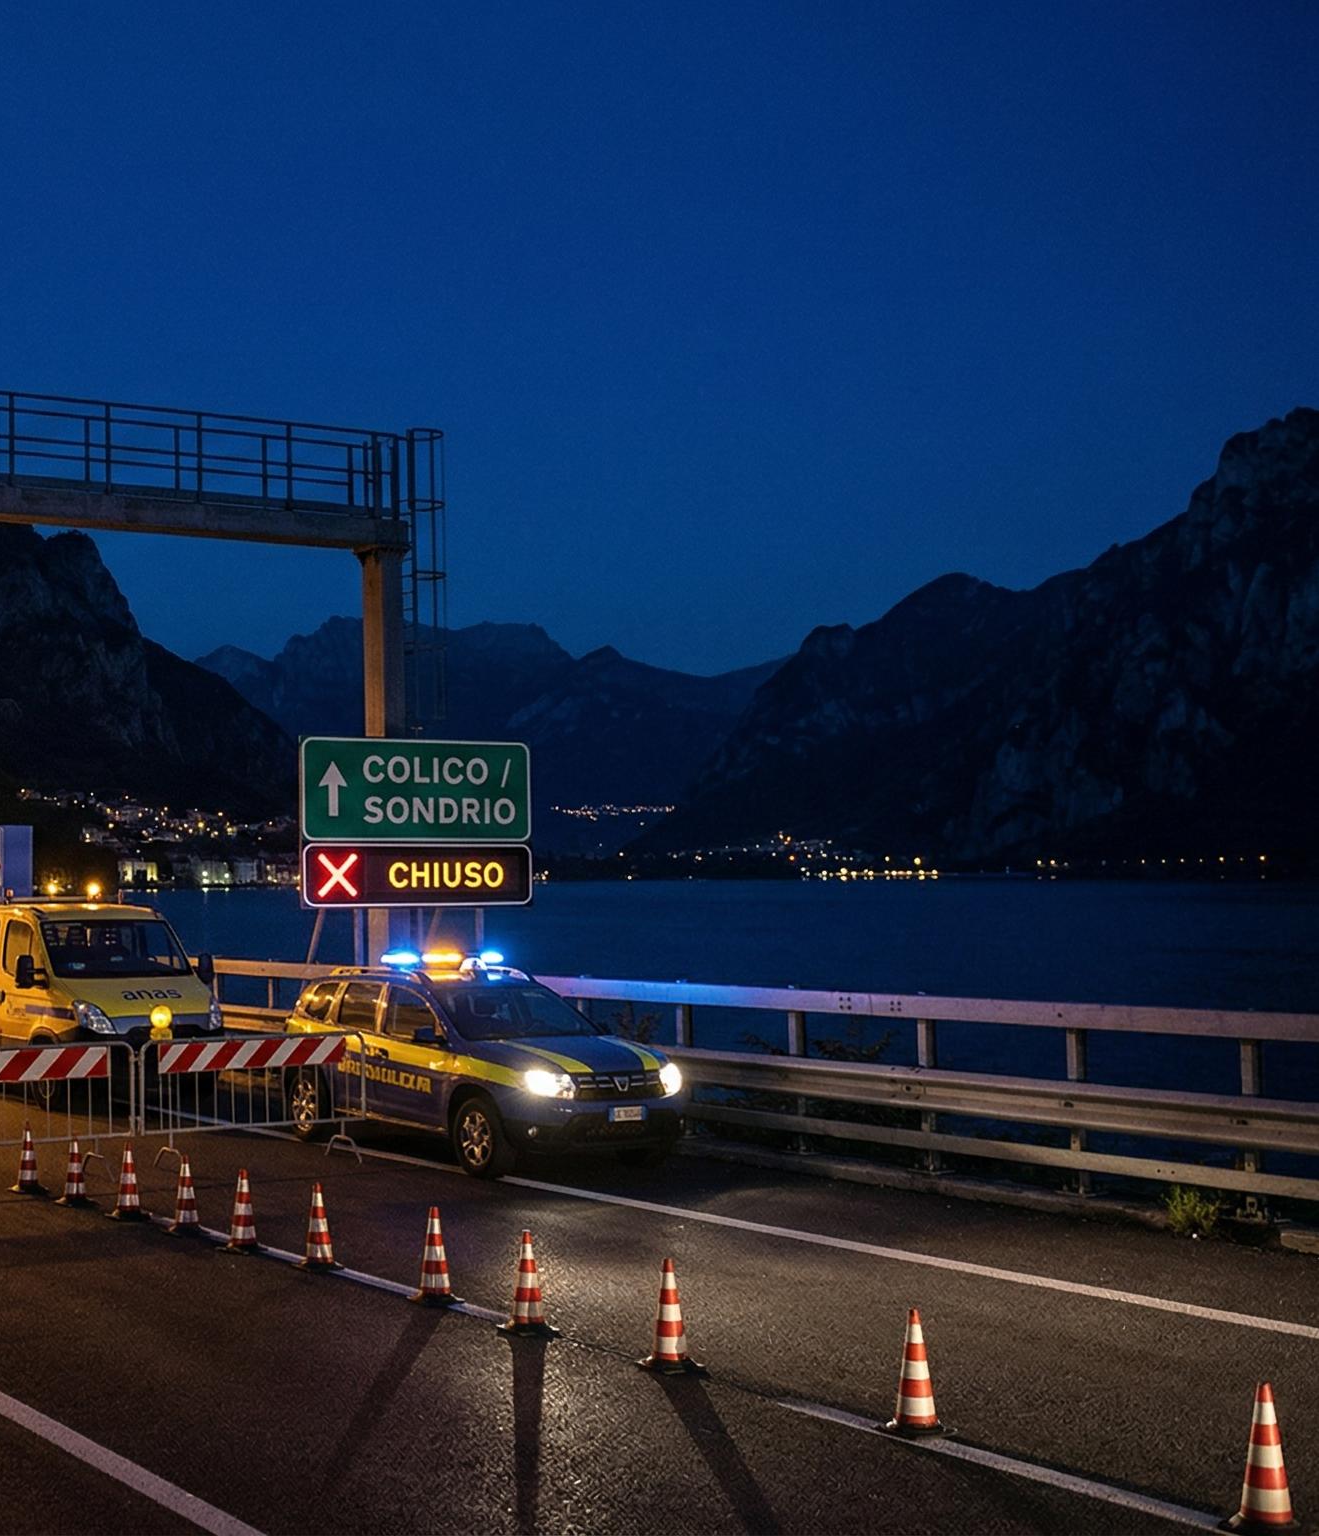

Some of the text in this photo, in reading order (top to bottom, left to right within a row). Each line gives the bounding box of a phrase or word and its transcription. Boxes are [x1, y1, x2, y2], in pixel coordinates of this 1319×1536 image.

[362, 755, 512, 788] COLICO /
[362, 796, 517, 825] SONDRIO
[387, 860, 505, 890] CHIUSO
[121, 988, 183, 1002] anas
